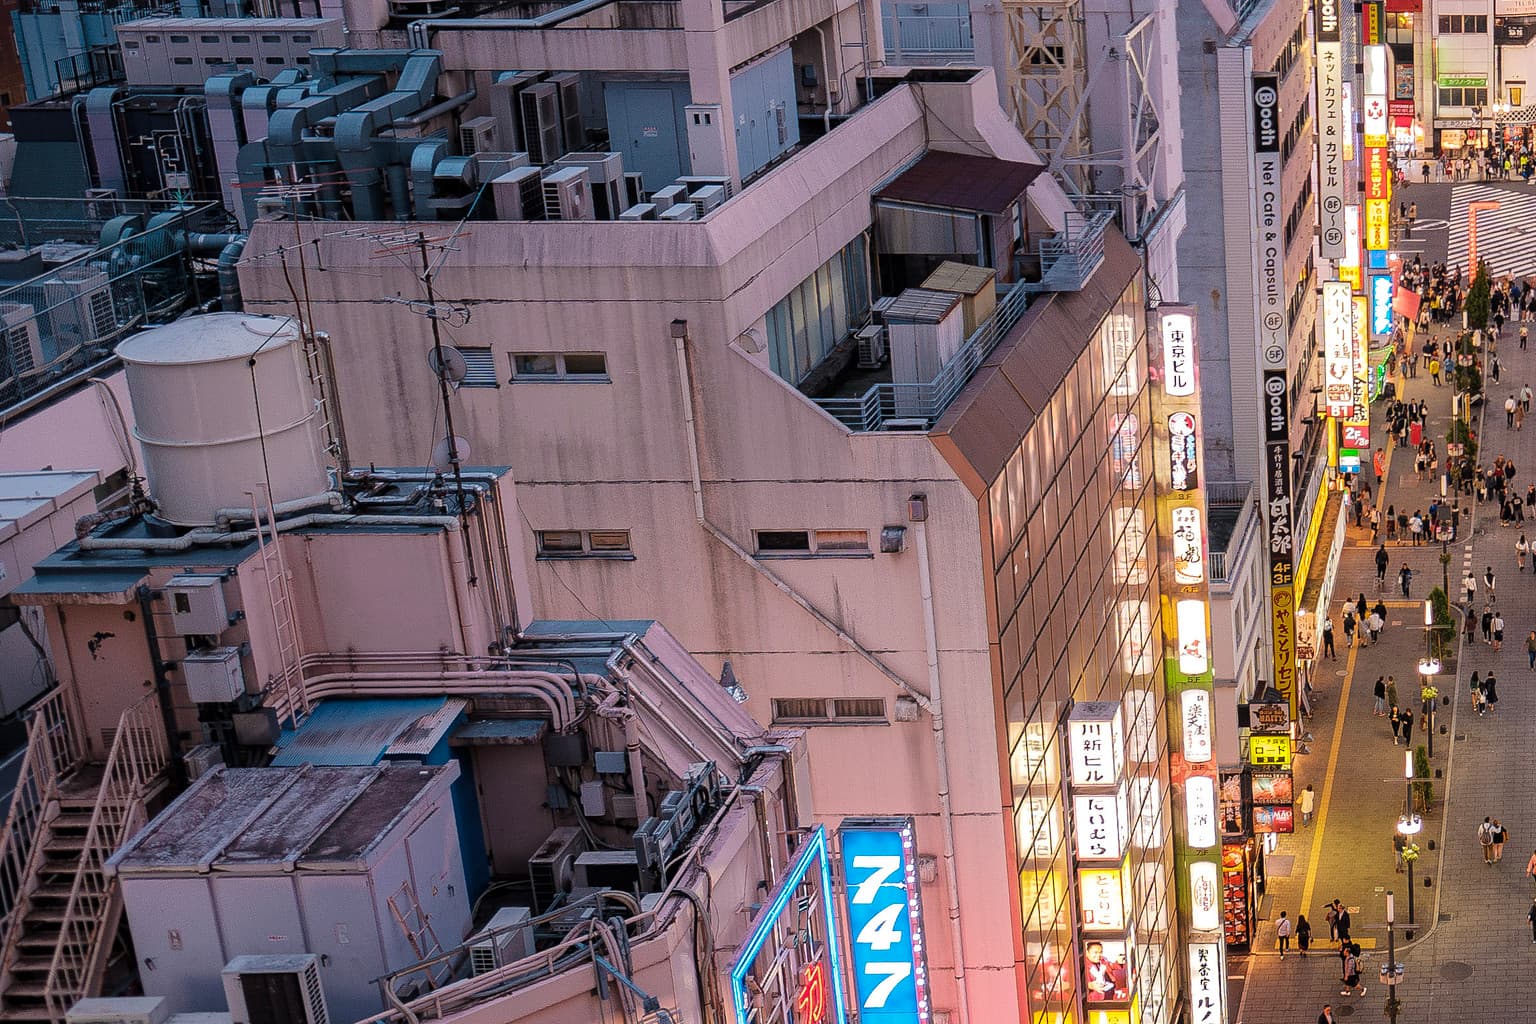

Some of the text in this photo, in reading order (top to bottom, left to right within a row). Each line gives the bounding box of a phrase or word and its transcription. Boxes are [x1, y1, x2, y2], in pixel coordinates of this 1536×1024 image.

[1324, 50, 1337, 119] ネットカフェ
[1255, 86, 1277, 146] Booth
[1326, 126, 1336, 136] &
[1262, 161, 1275, 186] Net
[1325, 141, 1338, 188] カプセル
[1263, 191, 1275, 227] Cafe
[1264, 232, 1276, 242] &
[1264, 247, 1278, 306] Capsule
[1171, 330, 1187, 388] 東京ビル
[1265, 375, 1286, 432] Booth
[1330, 406, 1350, 417] B1
[1269, 496, 1292, 555] 甘太郎
[1273, 562, 1292, 573] 4F
[1273, 573, 1292, 585] 3F
[1082, 724, 1103, 782] 川新ビル
[1255, 745, 1286, 755] ロード
[1088, 799, 1107, 855] にいむら
[852, 855, 911, 1009] 747
[1198, 948, 1210, 990] 喫茶室
